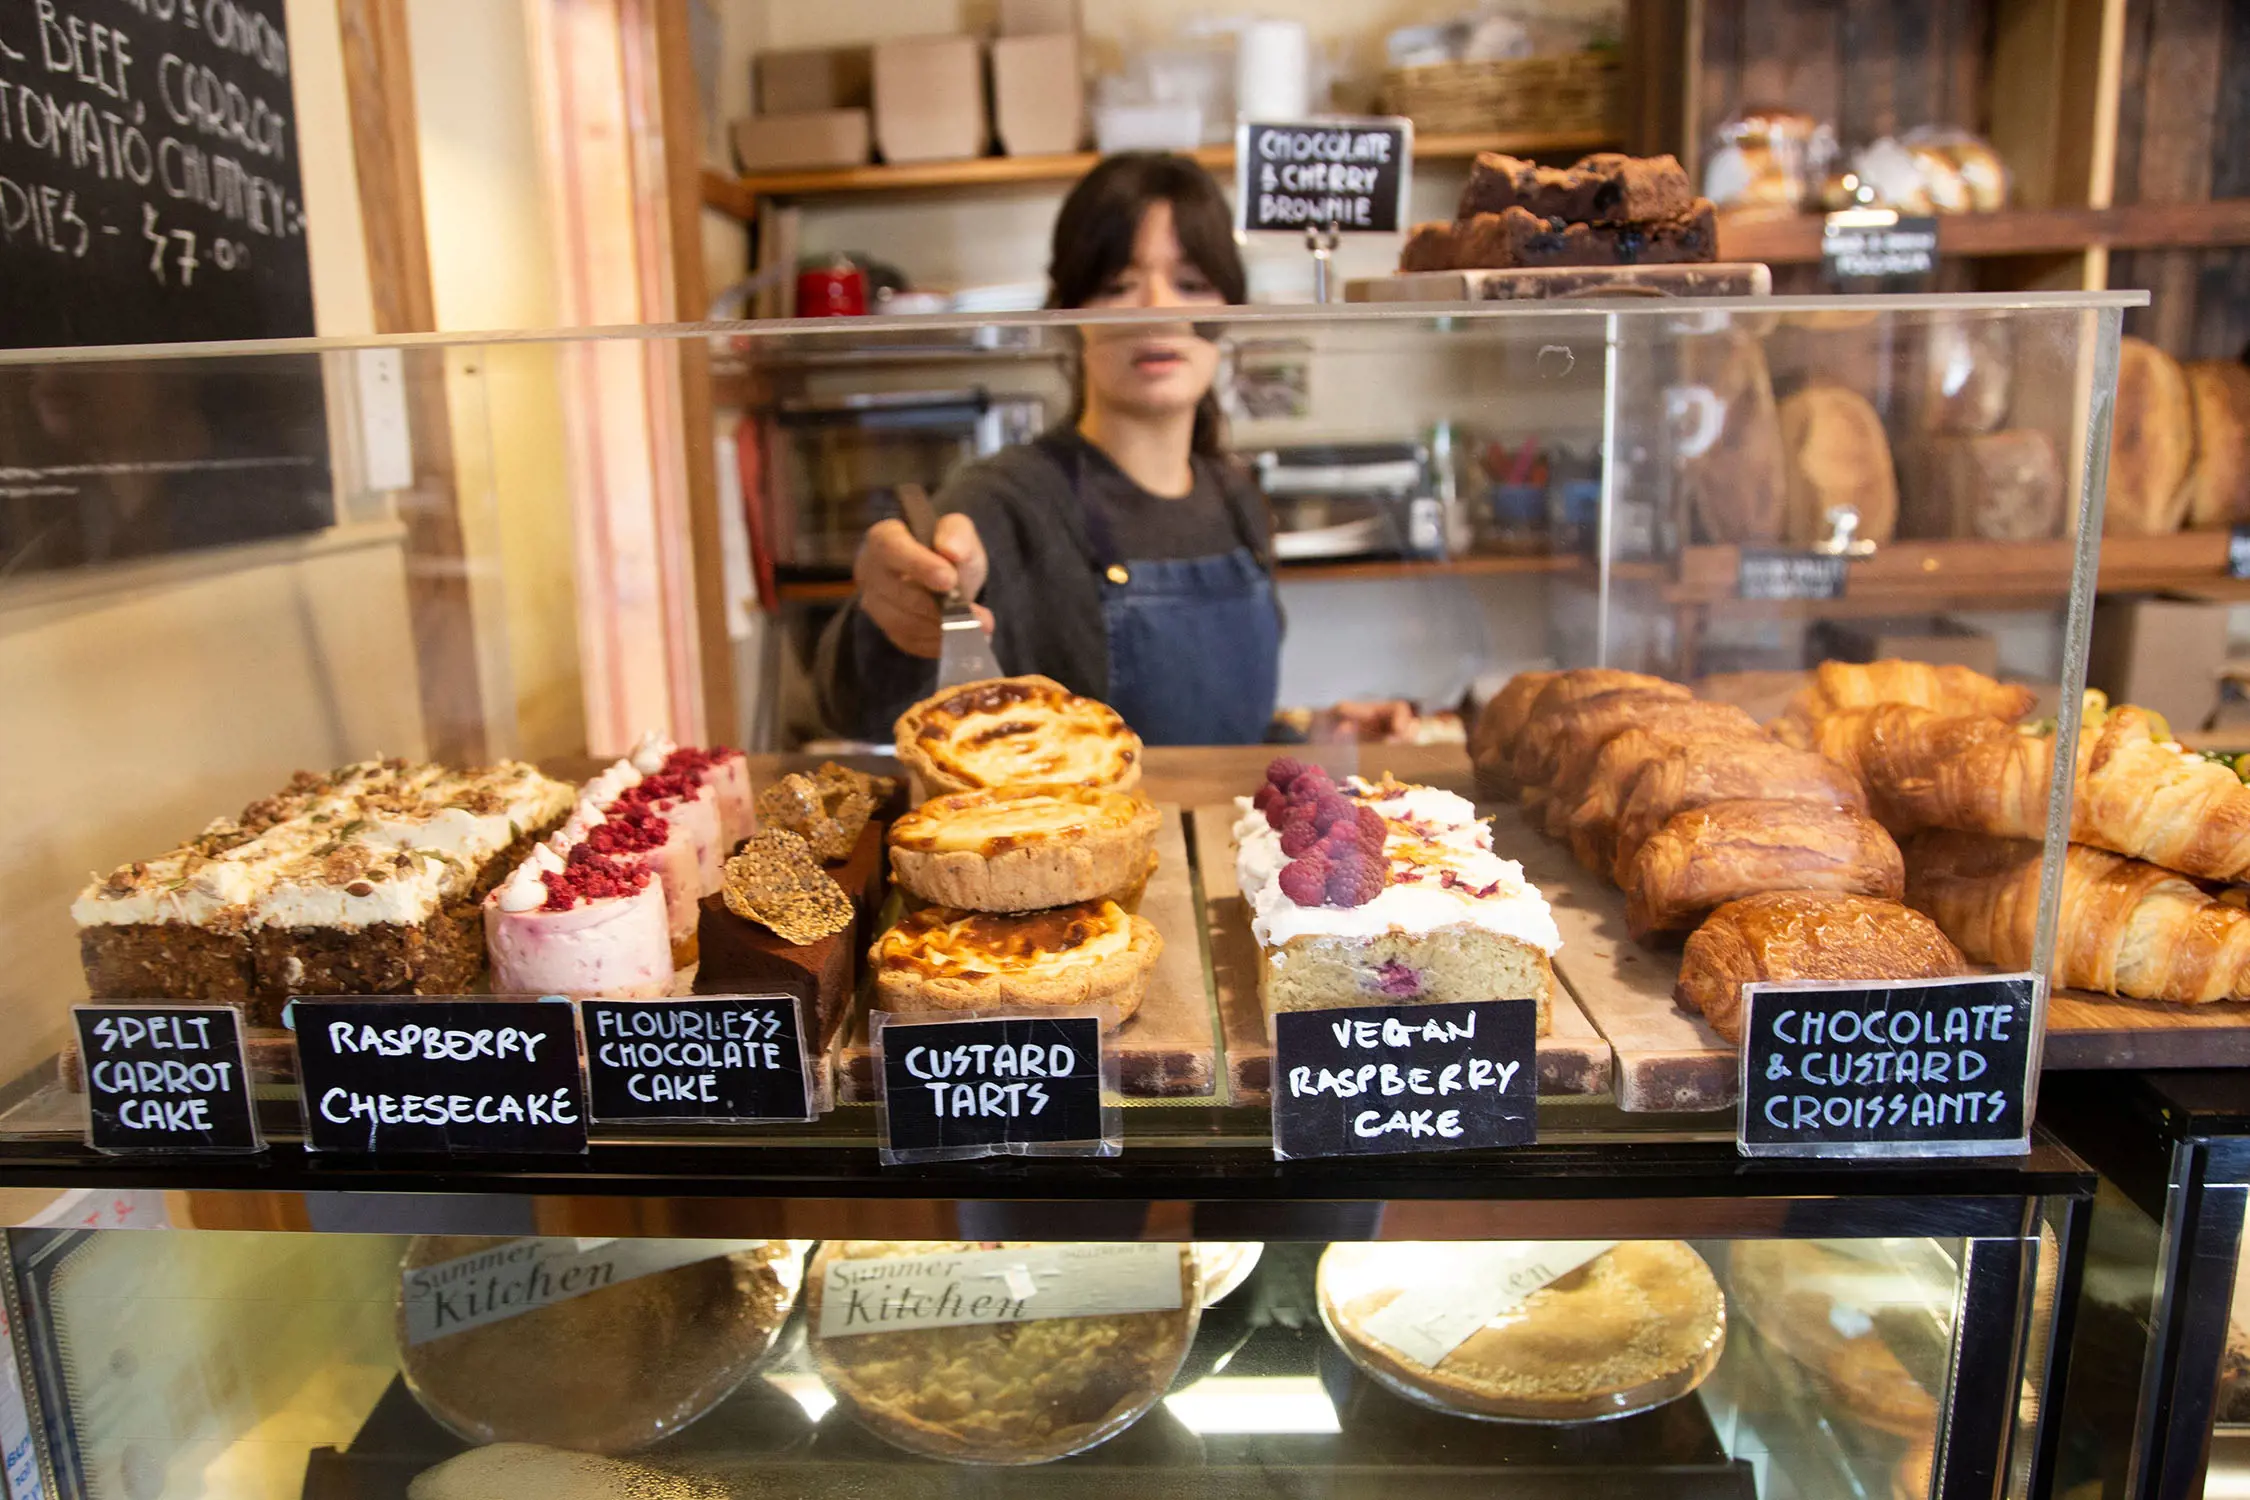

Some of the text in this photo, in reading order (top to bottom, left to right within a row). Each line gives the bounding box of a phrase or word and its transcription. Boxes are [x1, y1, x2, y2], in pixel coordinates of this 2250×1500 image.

[1258, 129, 1392, 164] CHOCOLATE
[1260, 162, 1380, 194] & CHERRY
[1258, 193, 1372, 226] BROWNIE
[93, 1016, 211, 1052] SPELT
[328, 1021, 547, 1063] RASPBERRY
[596, 1007, 783, 1041] FLOURLESS
[1331, 1009, 1477, 1049] VEGAN
[1772, 1004, 2014, 1045] CHOCOLATE
[599, 1041, 781, 1070] CHOCOLATE
[904, 1043, 1076, 1080] CUSTARD
[1764, 1050, 1988, 1087] & CUSTARD
[92, 1060, 233, 1094] CARROT
[627, 1069, 719, 1103] CAKE
[1288, 1058, 1520, 1099] RASPBERRY
[118, 1098, 214, 1132] CAKE
[319, 1086, 579, 1126] CHEESECAKE
[924, 1081, 1050, 1119] TARTS
[1763, 1090, 2007, 1130] CROISSANTS
[1353, 1108, 1465, 1139] CAKE
[410, 1240, 543, 1299] Summer
[827, 1257, 964, 1293] Summer
[433, 1258, 616, 1329] Kitchen
[844, 1278, 1027, 1327] Kitchen
